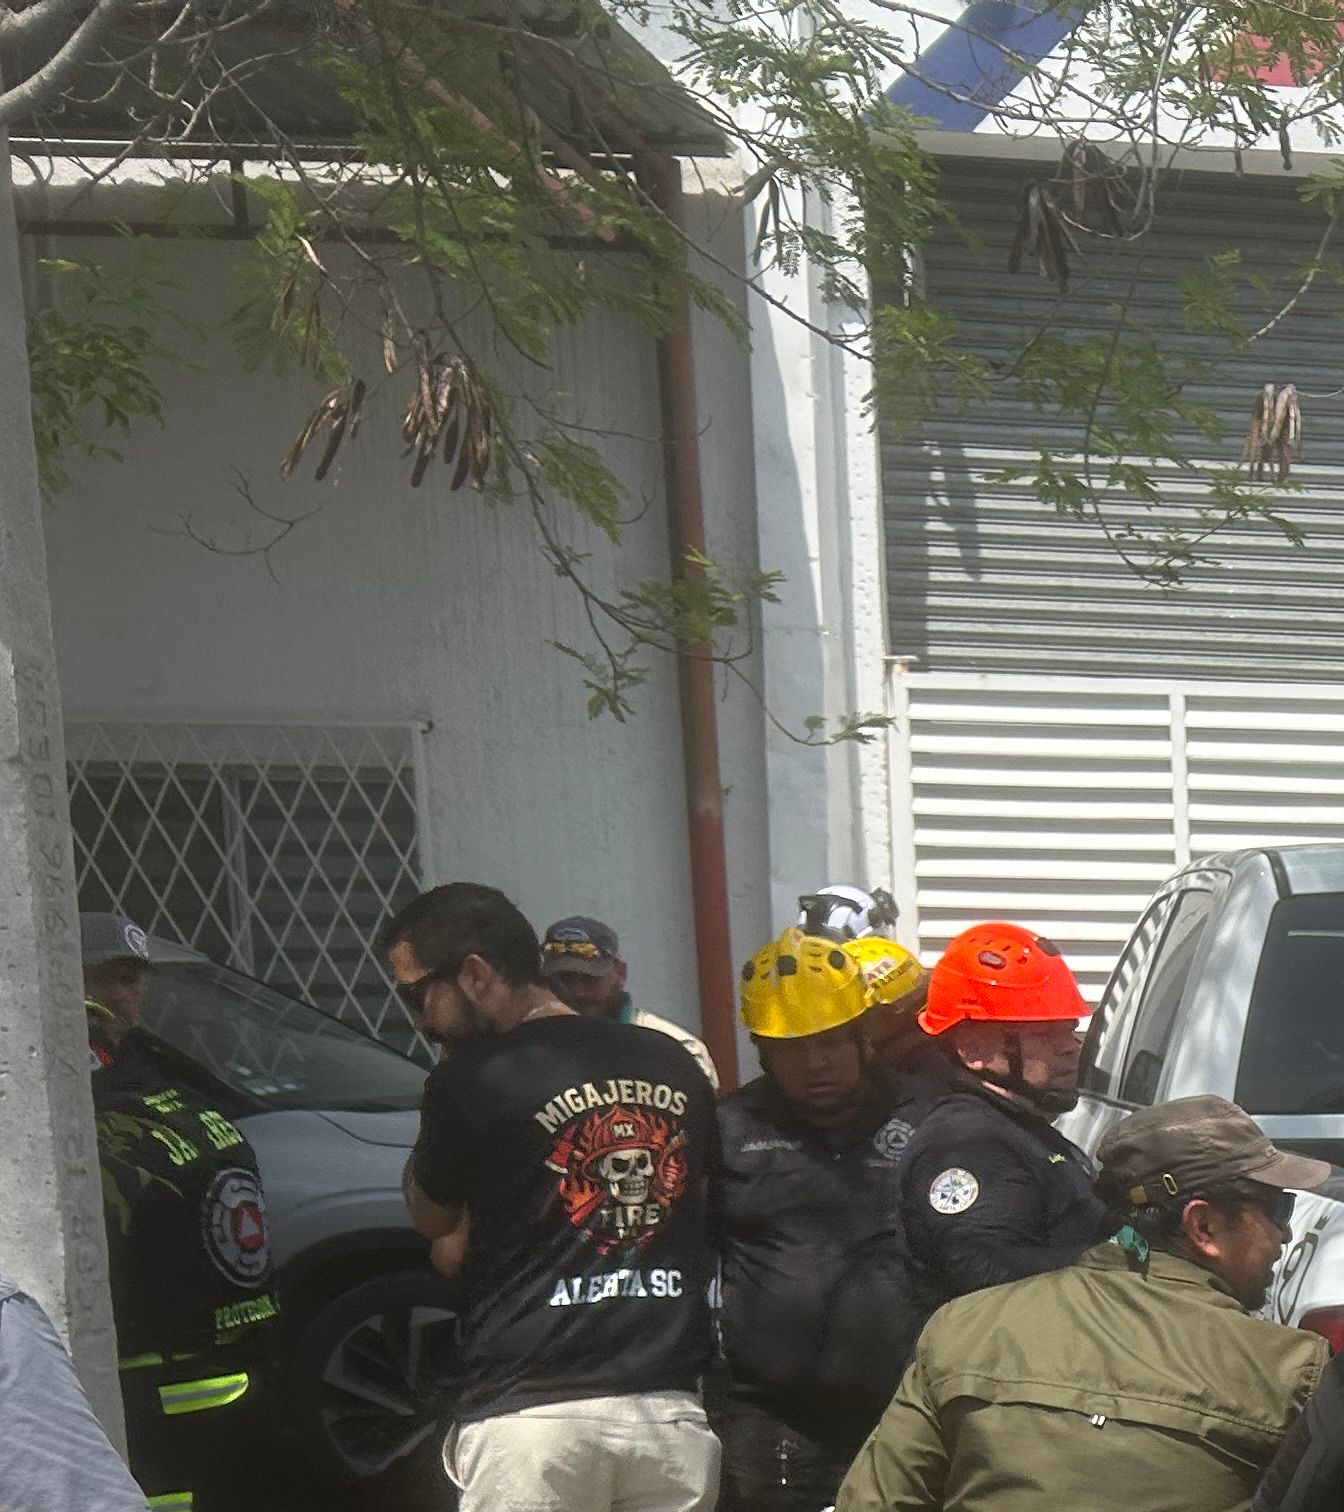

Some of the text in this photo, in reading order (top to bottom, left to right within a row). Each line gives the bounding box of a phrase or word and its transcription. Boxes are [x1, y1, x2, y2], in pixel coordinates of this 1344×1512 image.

[534, 1078, 688, 1135] MIGAJEROS
[611, 1122, 636, 1139] MX
[549, 1268, 683, 1307] ALERTA SC
